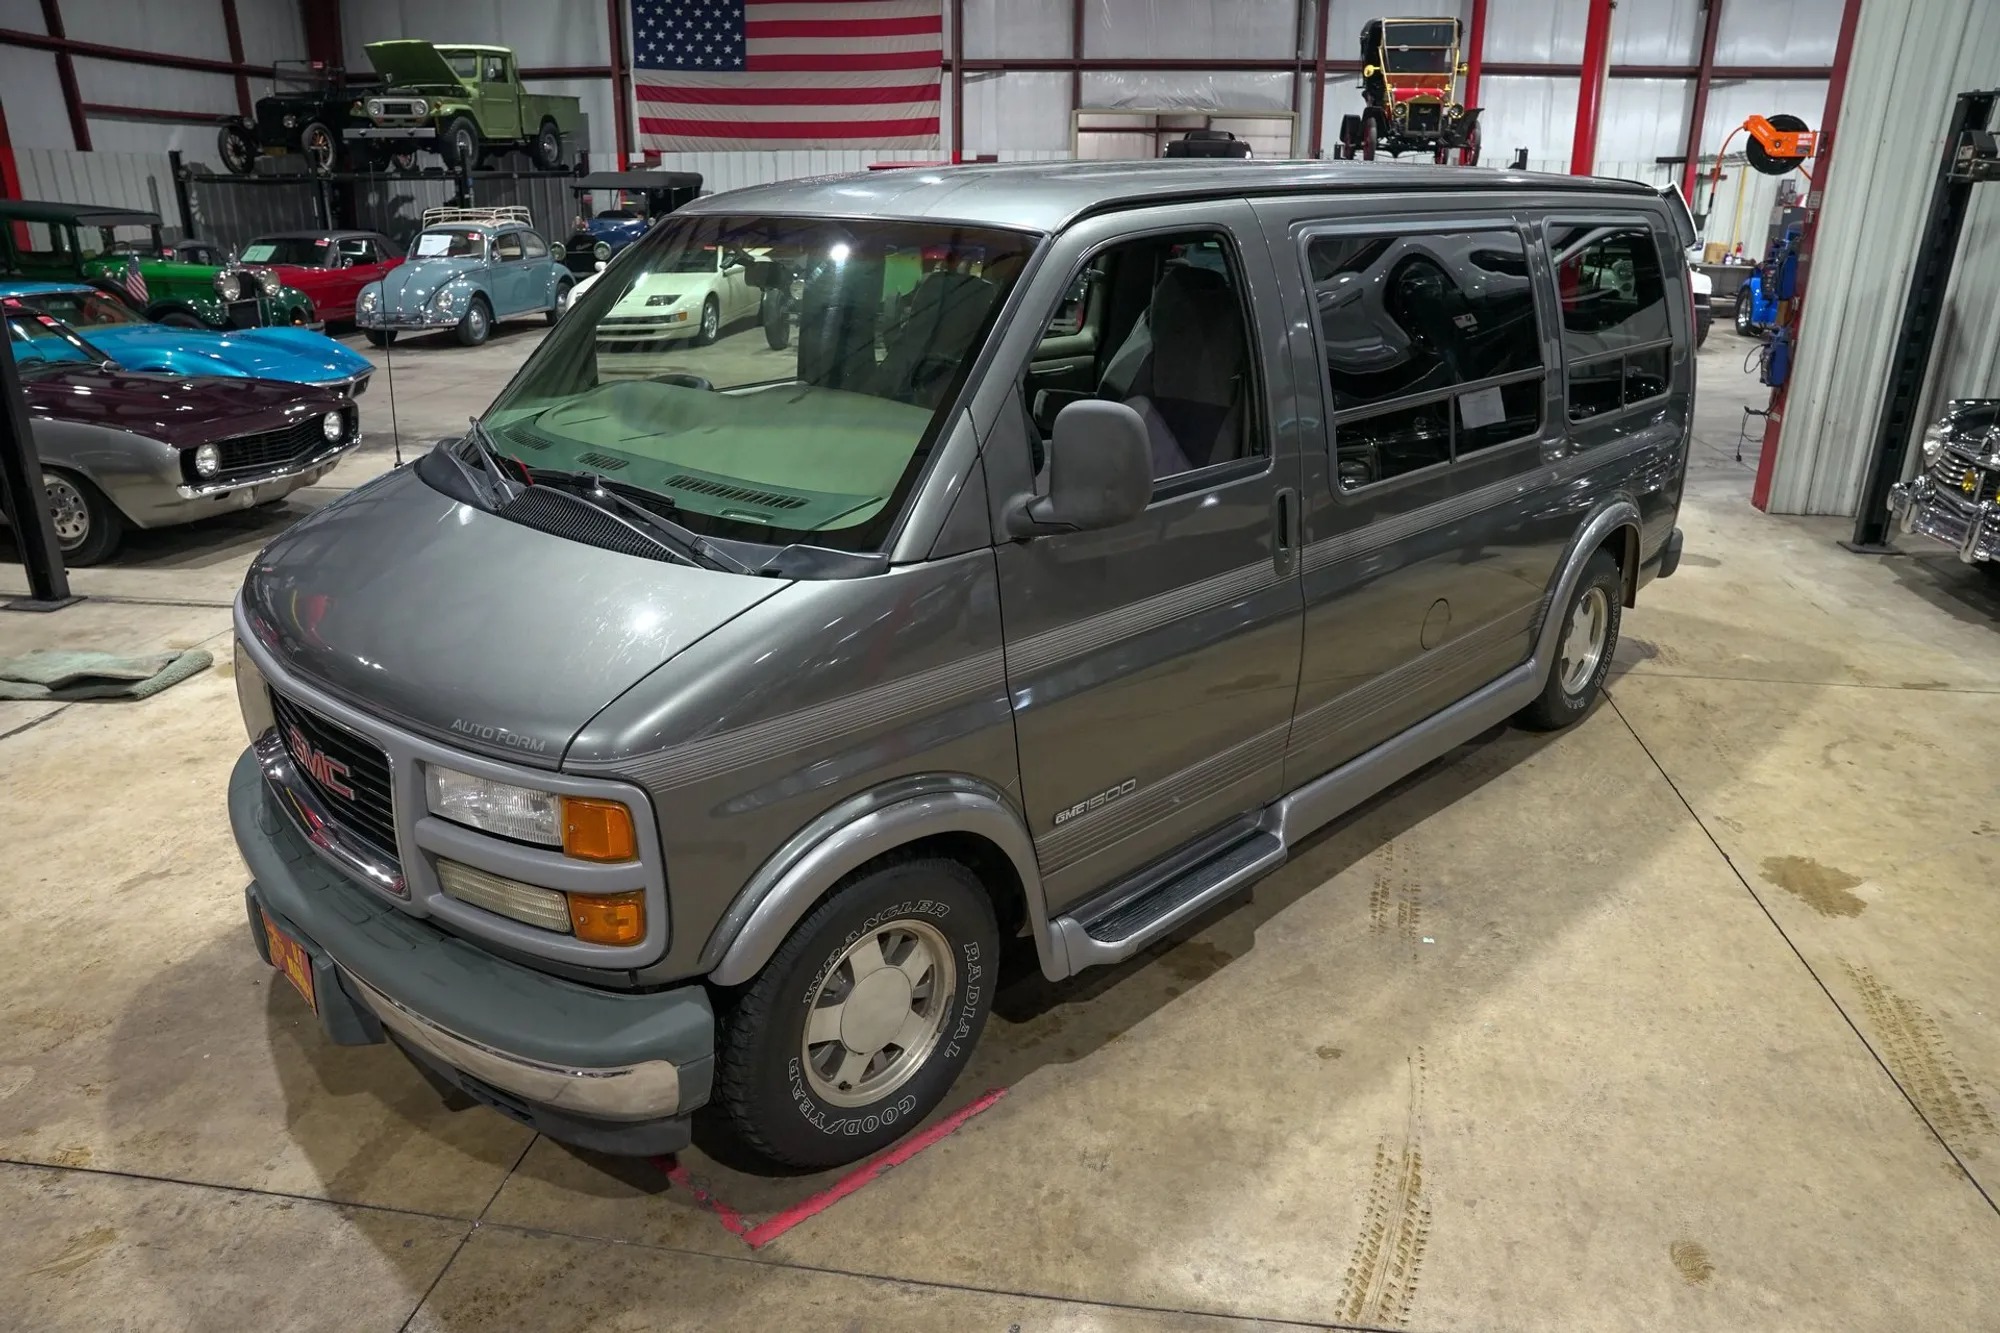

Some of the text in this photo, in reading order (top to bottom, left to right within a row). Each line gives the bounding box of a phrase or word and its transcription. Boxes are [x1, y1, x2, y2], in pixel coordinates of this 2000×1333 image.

[289, 724, 355, 801] GMC
[450, 718, 546, 752] AUTO FORM
[943, 941, 982, 1058] RADIAL
[788, 1057, 917, 1136] GOODYEAR
